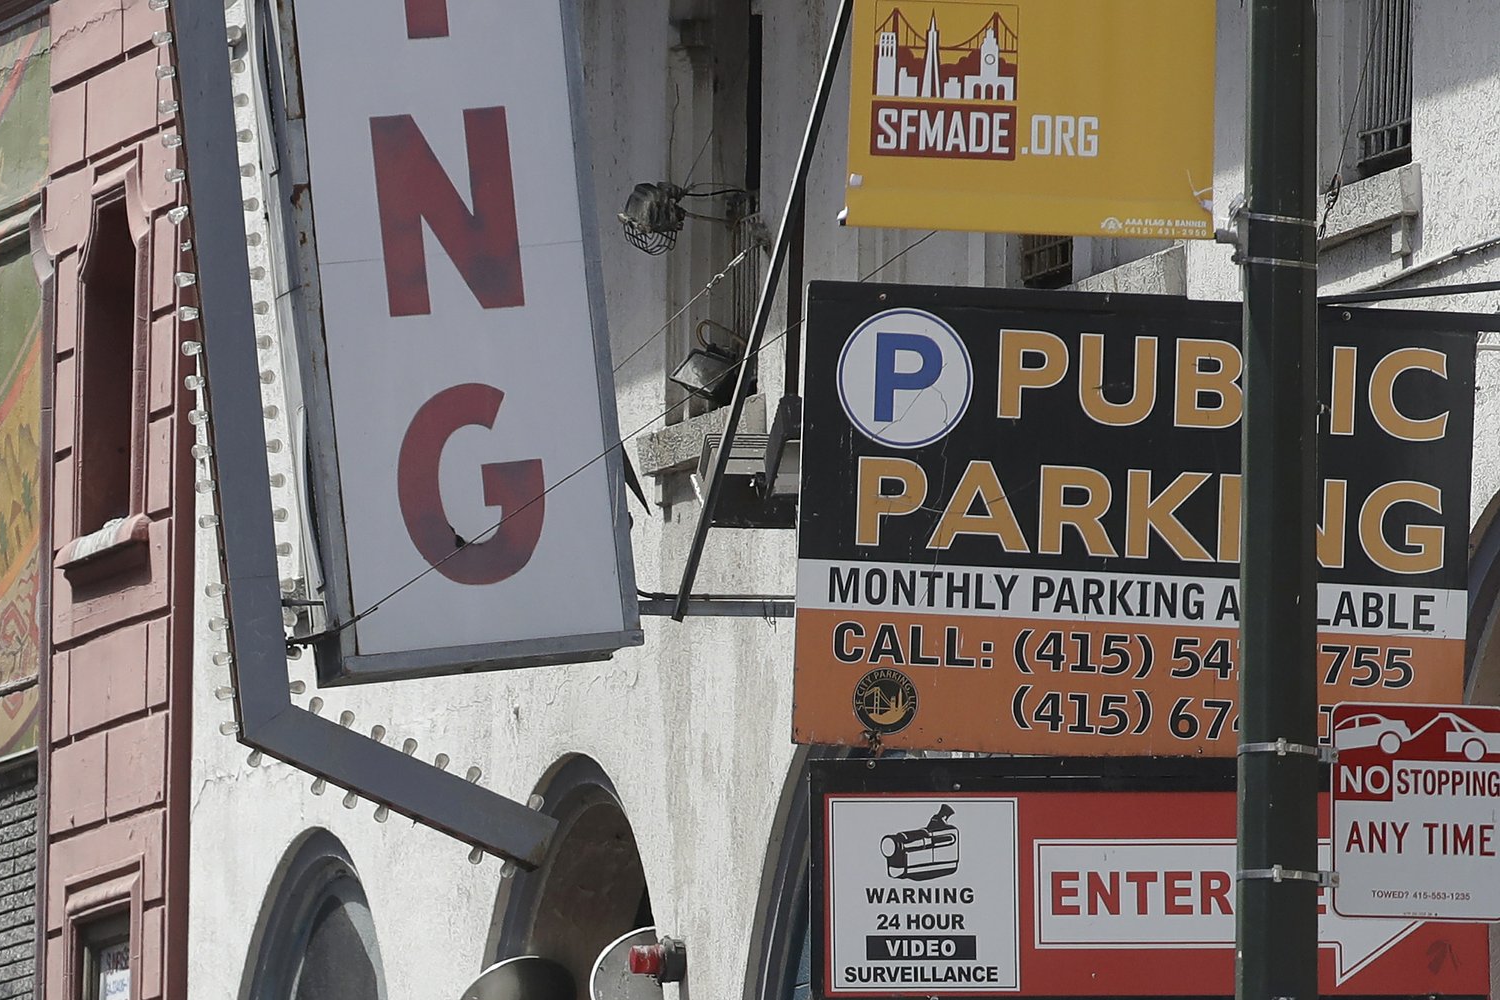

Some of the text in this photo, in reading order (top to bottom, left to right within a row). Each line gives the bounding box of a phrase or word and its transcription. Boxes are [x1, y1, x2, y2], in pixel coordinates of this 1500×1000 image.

[369, 0, 545, 585] NG
[874, 331, 943, 423] P
[997, 329, 1449, 442] PUBIC
[828, 566, 1436, 632] MONTHLY PARKING AABLE
[832, 620, 995, 669] CALL:
[1012, 627, 1155, 680] (415)
[857, 676, 873, 697] CITY
[1011, 683, 1153, 736] (415)
[1340, 765, 1500, 798] NO STOPPING
[1345, 821, 1496, 857] ANY TIME
[865, 887, 974, 904] WARNING
[1051, 870, 1235, 915] ENTER
[1371, 889, 1471, 900] TOWED? 415-553-1235
[877, 913, 965, 930] 24 HOUR
[885, 939, 956, 957] VIDEO
[844, 966, 999, 983] SURVEILLANCE
